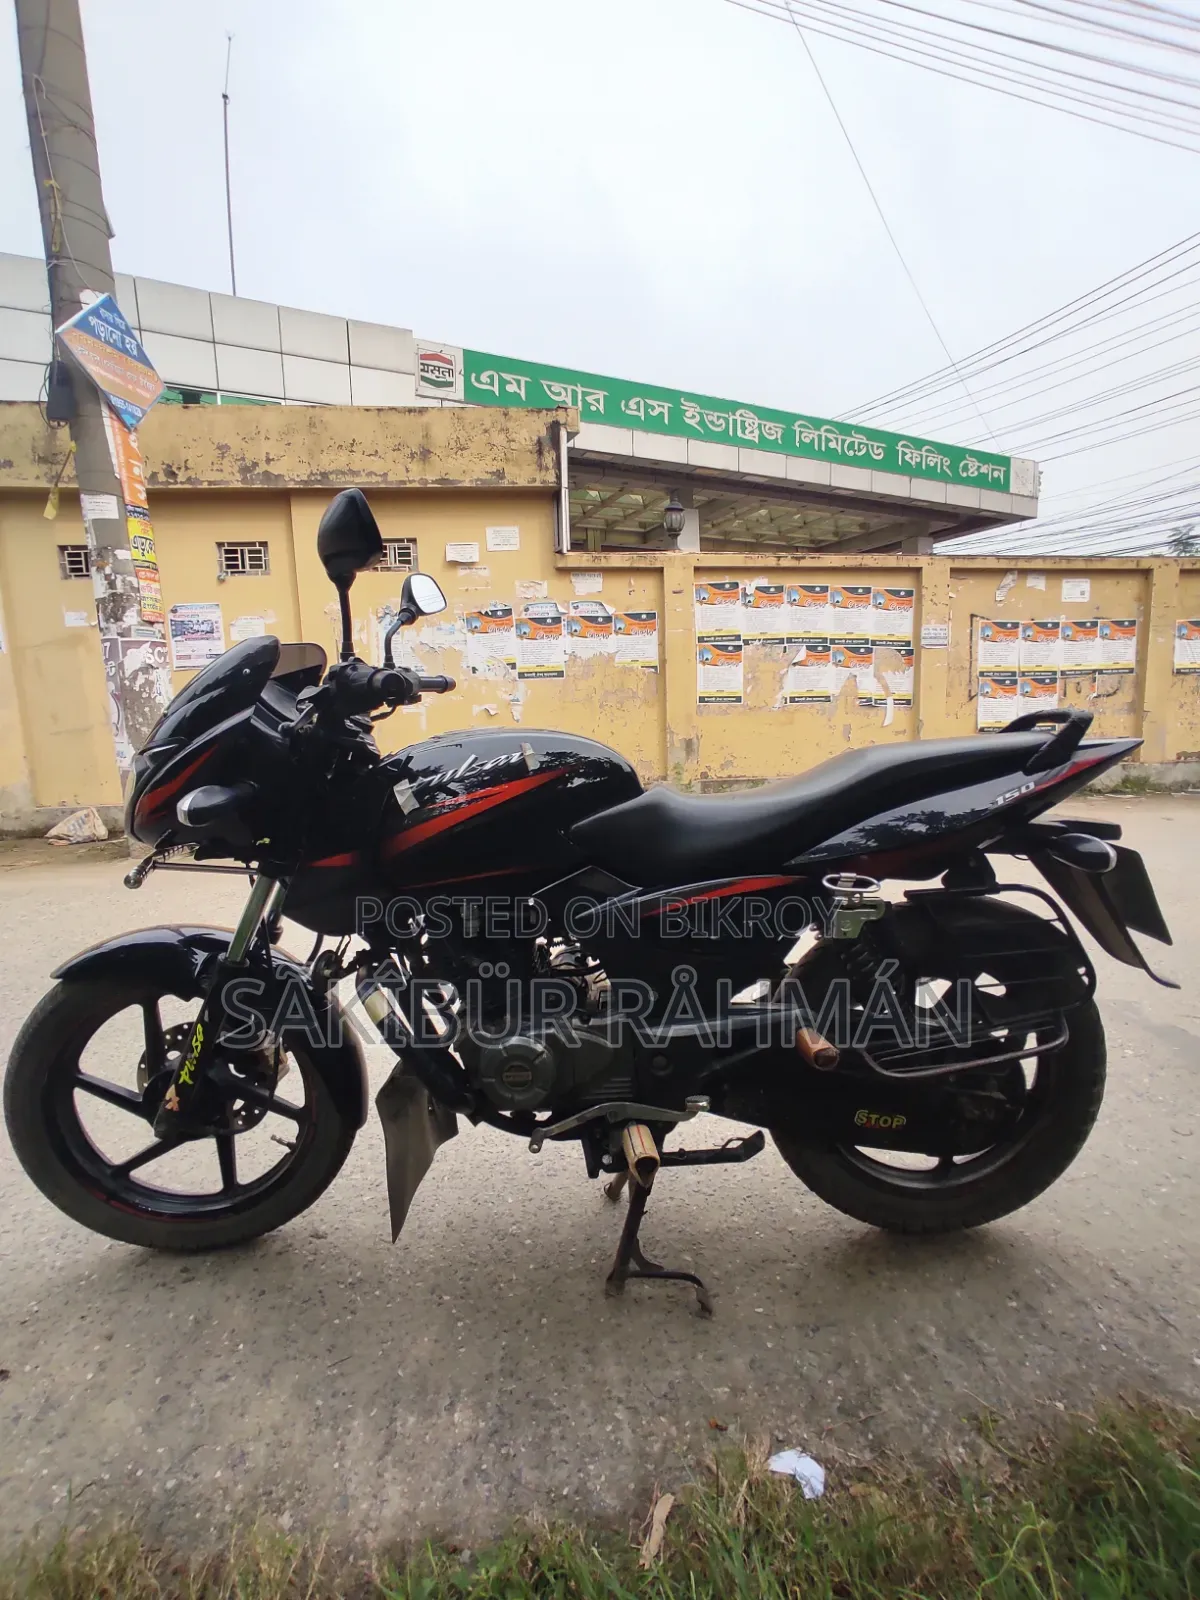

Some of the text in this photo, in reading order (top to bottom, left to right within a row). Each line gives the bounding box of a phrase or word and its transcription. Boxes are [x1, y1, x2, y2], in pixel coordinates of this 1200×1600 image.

[88, 315, 122, 349] পড়ানো
[471, 371, 531, 401] এম
[540, 383, 610, 415] আর
[621, 397, 673, 426] এস
[791, 420, 887, 460] লিমিটেড
[896, 440, 952, 478] ফিলিং
[995, 781, 1036, 805] 150
[858, 1112, 904, 1129] STOP
